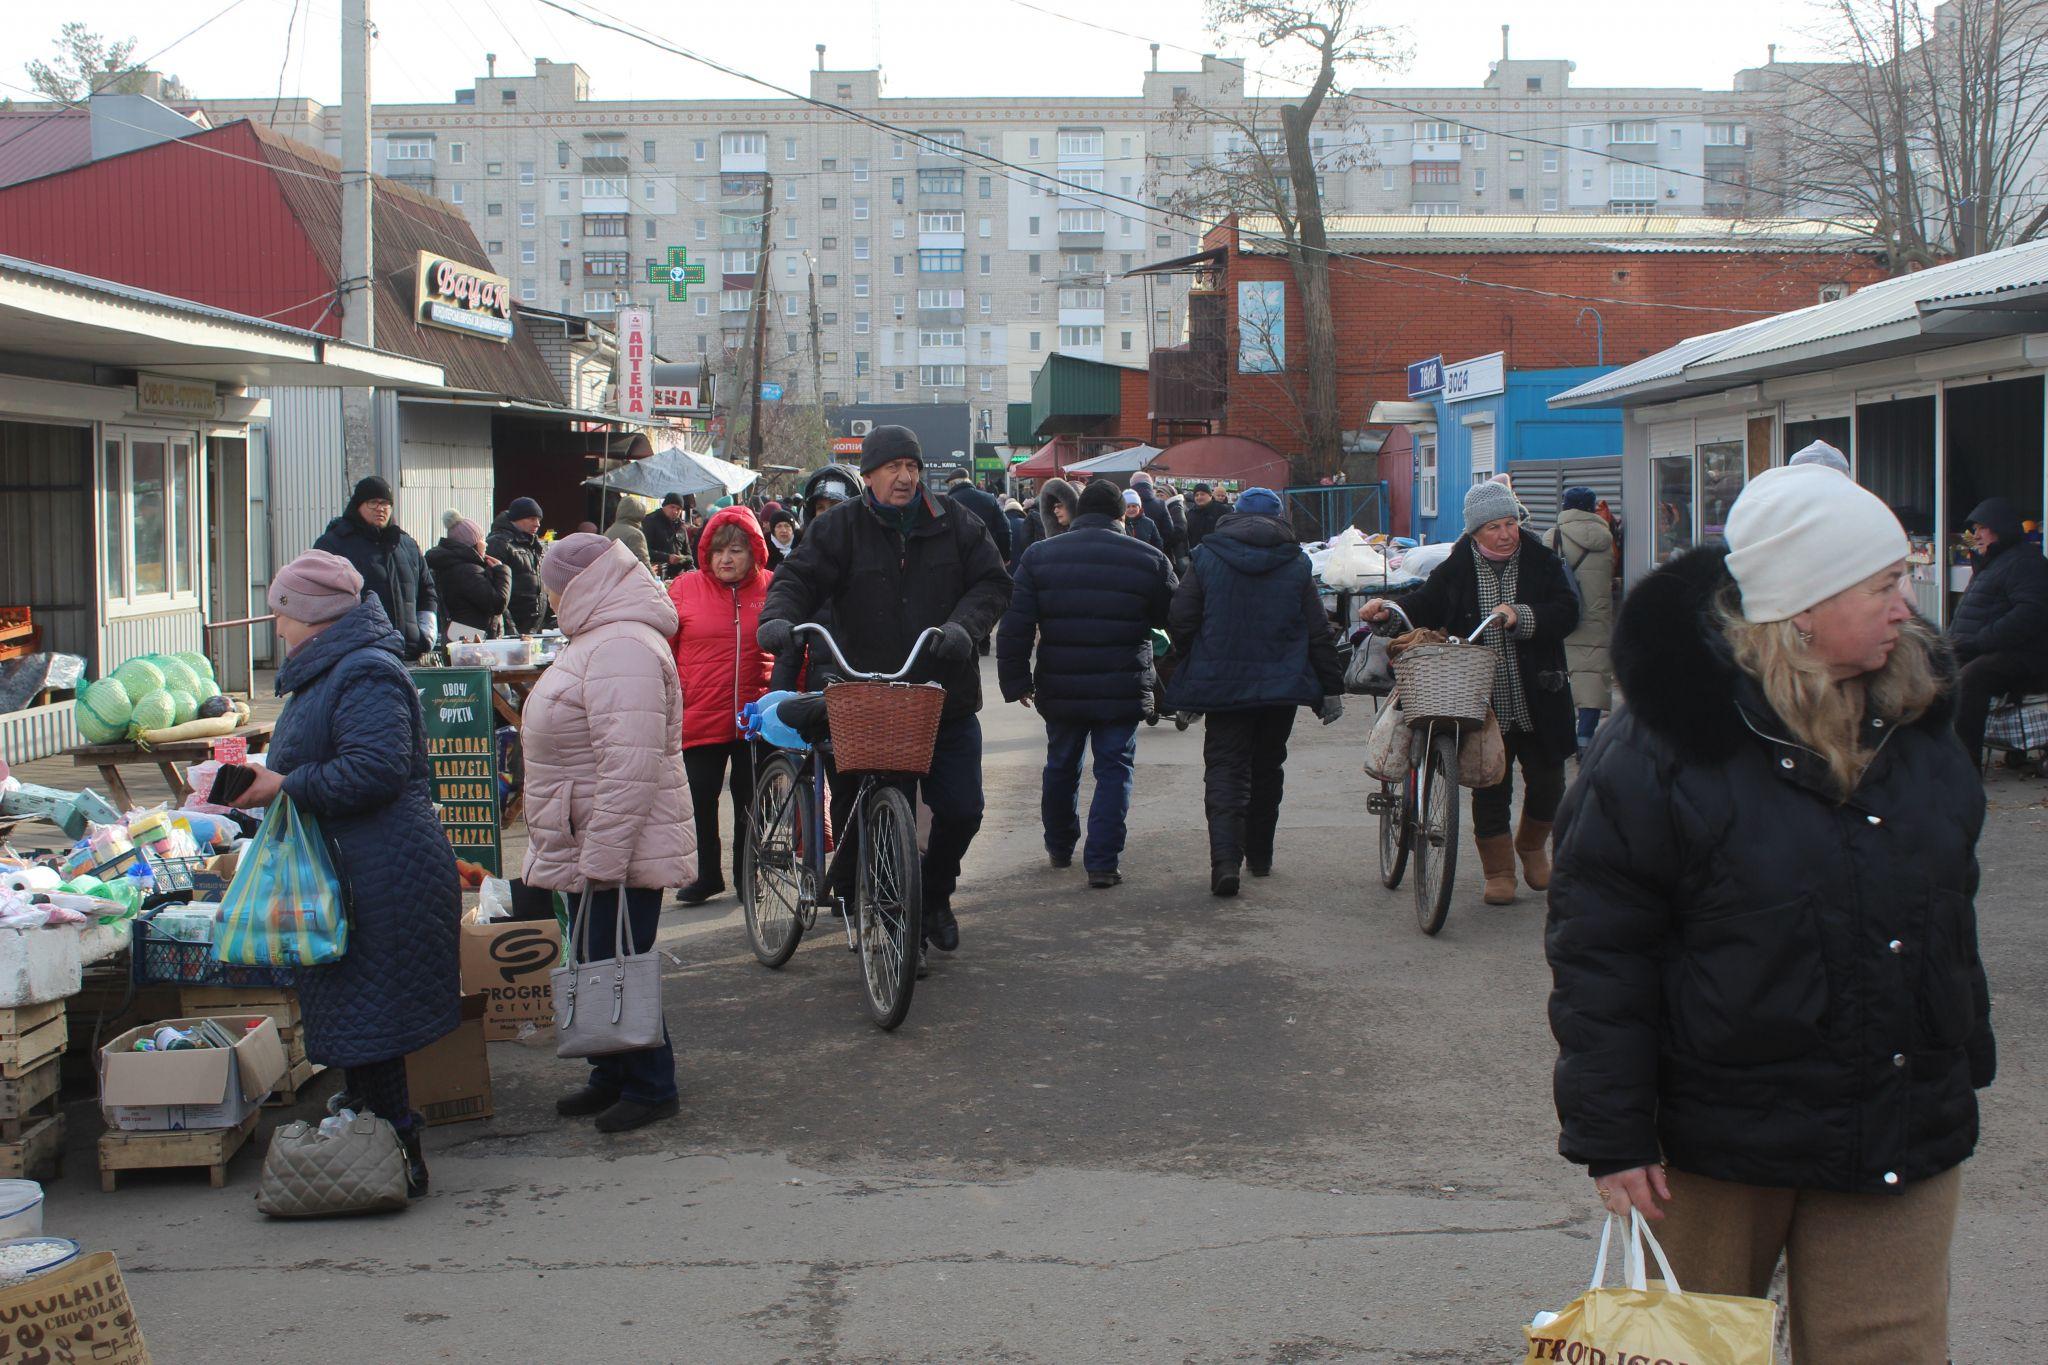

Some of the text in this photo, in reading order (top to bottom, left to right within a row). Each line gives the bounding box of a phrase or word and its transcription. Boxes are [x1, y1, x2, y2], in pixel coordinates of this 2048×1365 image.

[437, 261, 511, 319] Вацак
[628, 331, 644, 413] АПТЕКА
[654, 390, 692, 406] ЕКА
[442, 682, 467, 697] ОВОЧІ
[439, 706, 474, 723] ФРУКТИ
[434, 760, 490, 776] КАПУСТА
[440, 783, 491, 799] МОРКВА
[440, 806, 492, 822] ПЕКІНКА
[446, 828, 494, 844] ЯБЛУКА
[494, 999, 555, 1013] ervic
